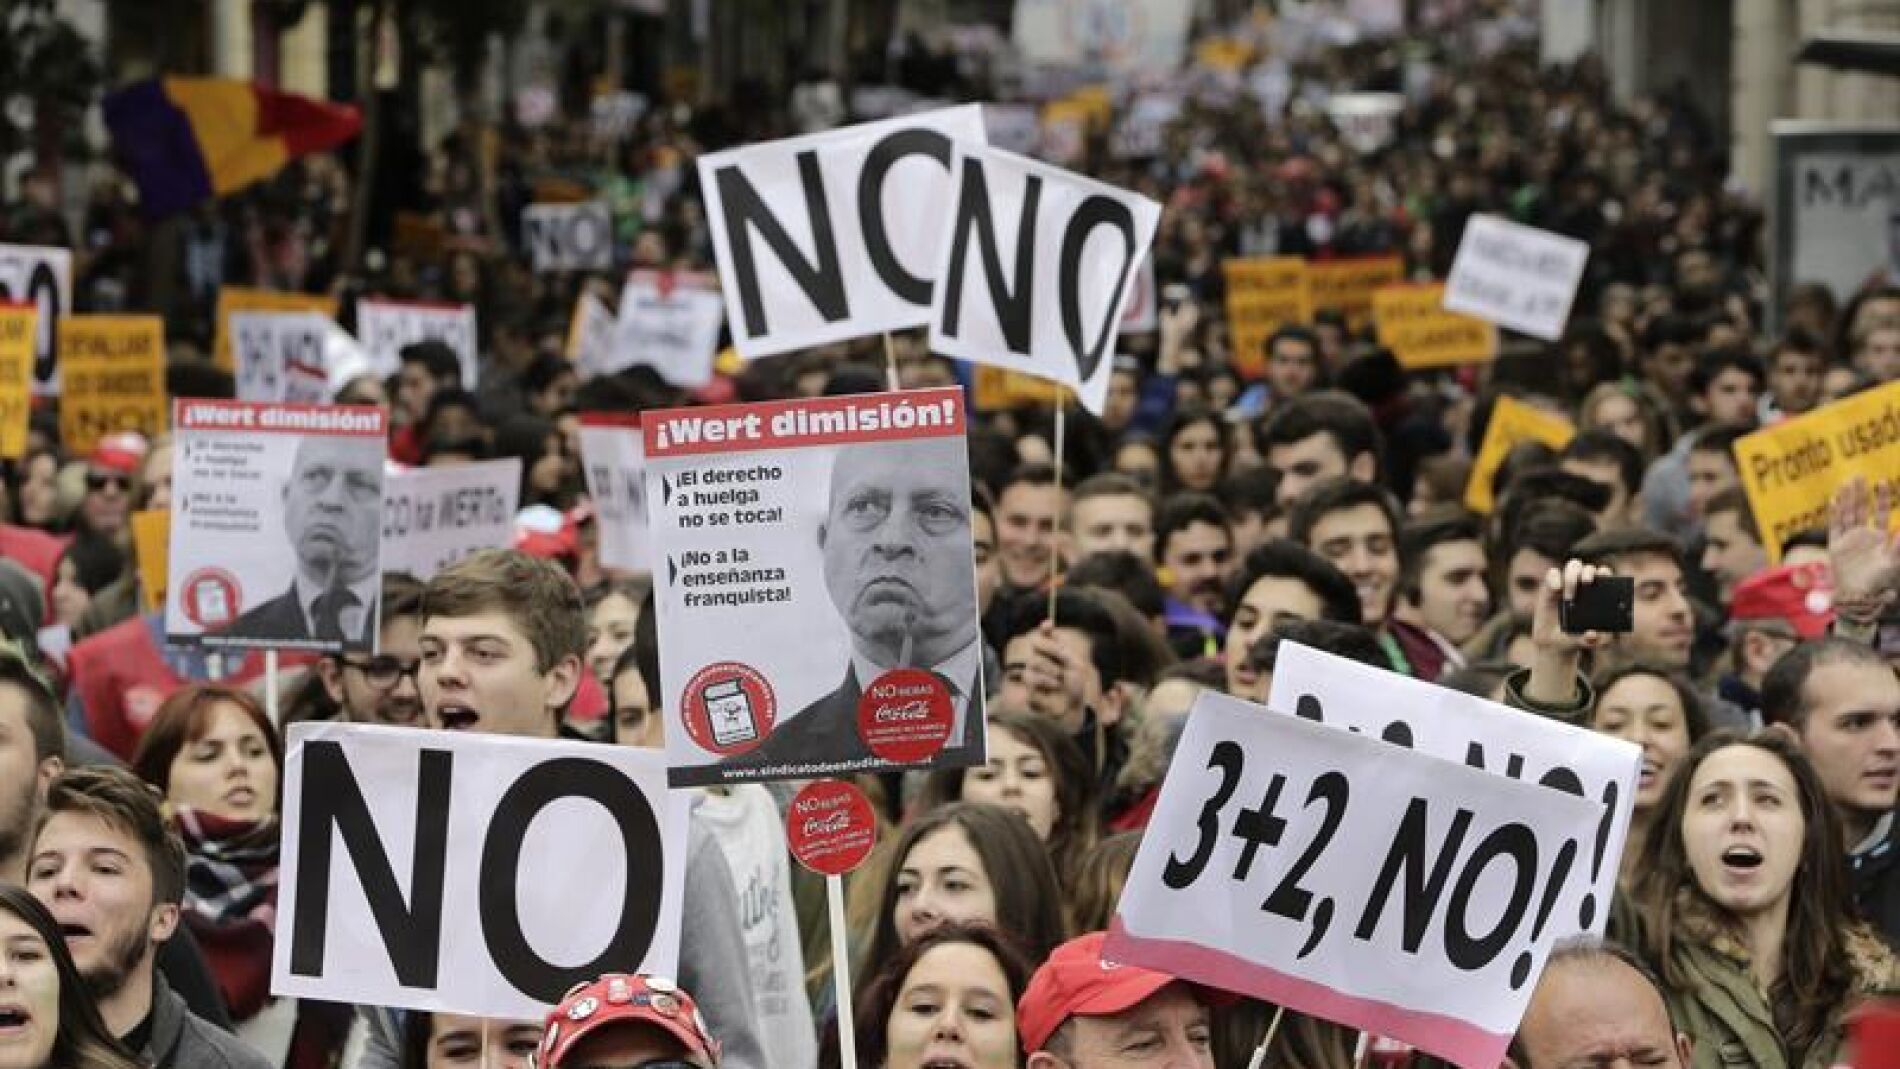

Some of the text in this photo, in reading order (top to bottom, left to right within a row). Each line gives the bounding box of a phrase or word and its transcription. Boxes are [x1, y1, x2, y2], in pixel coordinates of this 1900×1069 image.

[941, 156, 1136, 382] NO
[656, 398, 955, 449] ¡Wert dimisión!
[676, 464, 782, 488] ¡El derecho
[677, 488, 760, 507] a huelga
[679, 507, 783, 528] no se toca!
[681, 548, 749, 568] ¡No a la
[682, 566, 785, 587] enseñanza
[683, 587, 792, 608] franquista!
[289, 740, 664, 1006] NO
[1161, 740, 1351, 959] 3+2,
[1353, 796, 1579, 991] NO!
